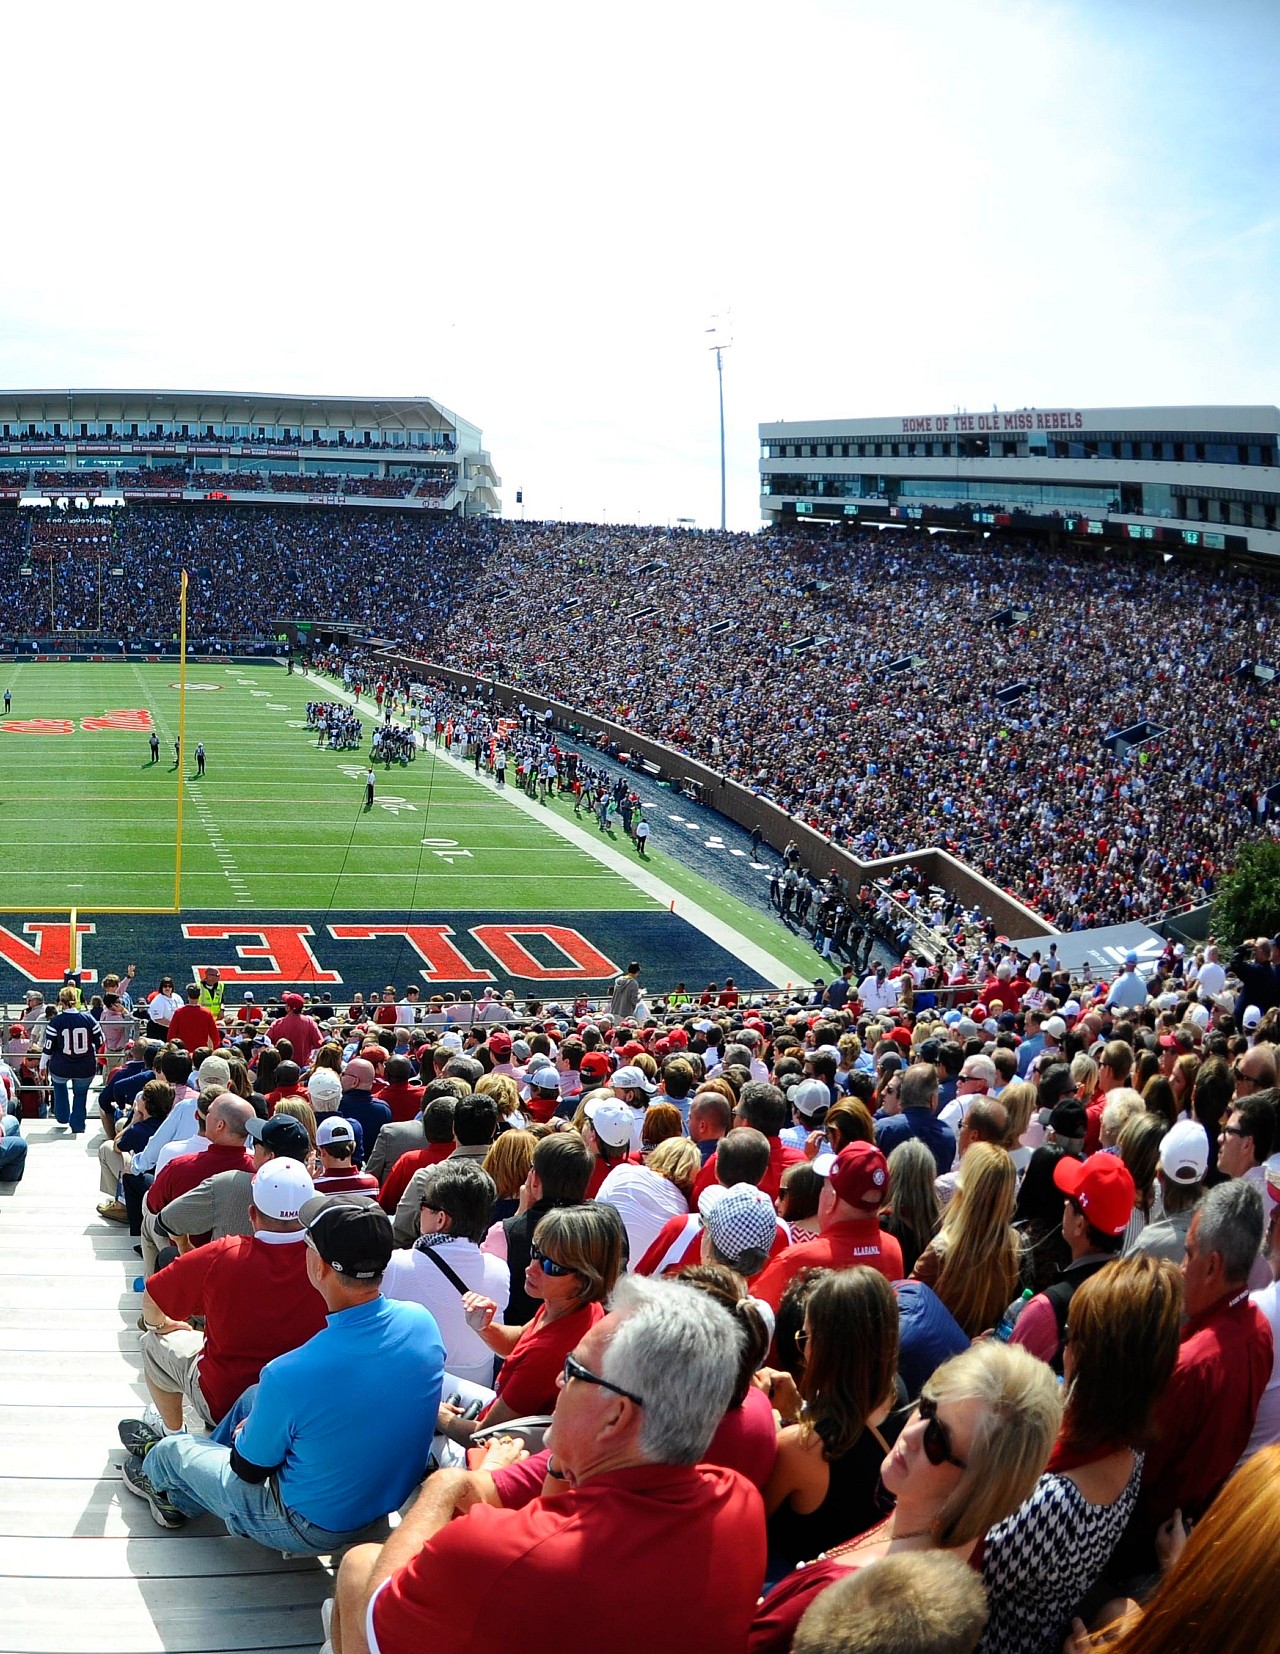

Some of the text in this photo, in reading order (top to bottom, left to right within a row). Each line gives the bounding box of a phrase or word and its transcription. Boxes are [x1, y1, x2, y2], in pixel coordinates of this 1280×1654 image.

[902, 412, 1083, 432] HOME OF THE OLE MISS REBELS
[373, 796, 419, 812] 20
[420, 838, 474, 857] 10
[180, 923, 625, 984] OLE
[61, 1027, 89, 1055] 10
